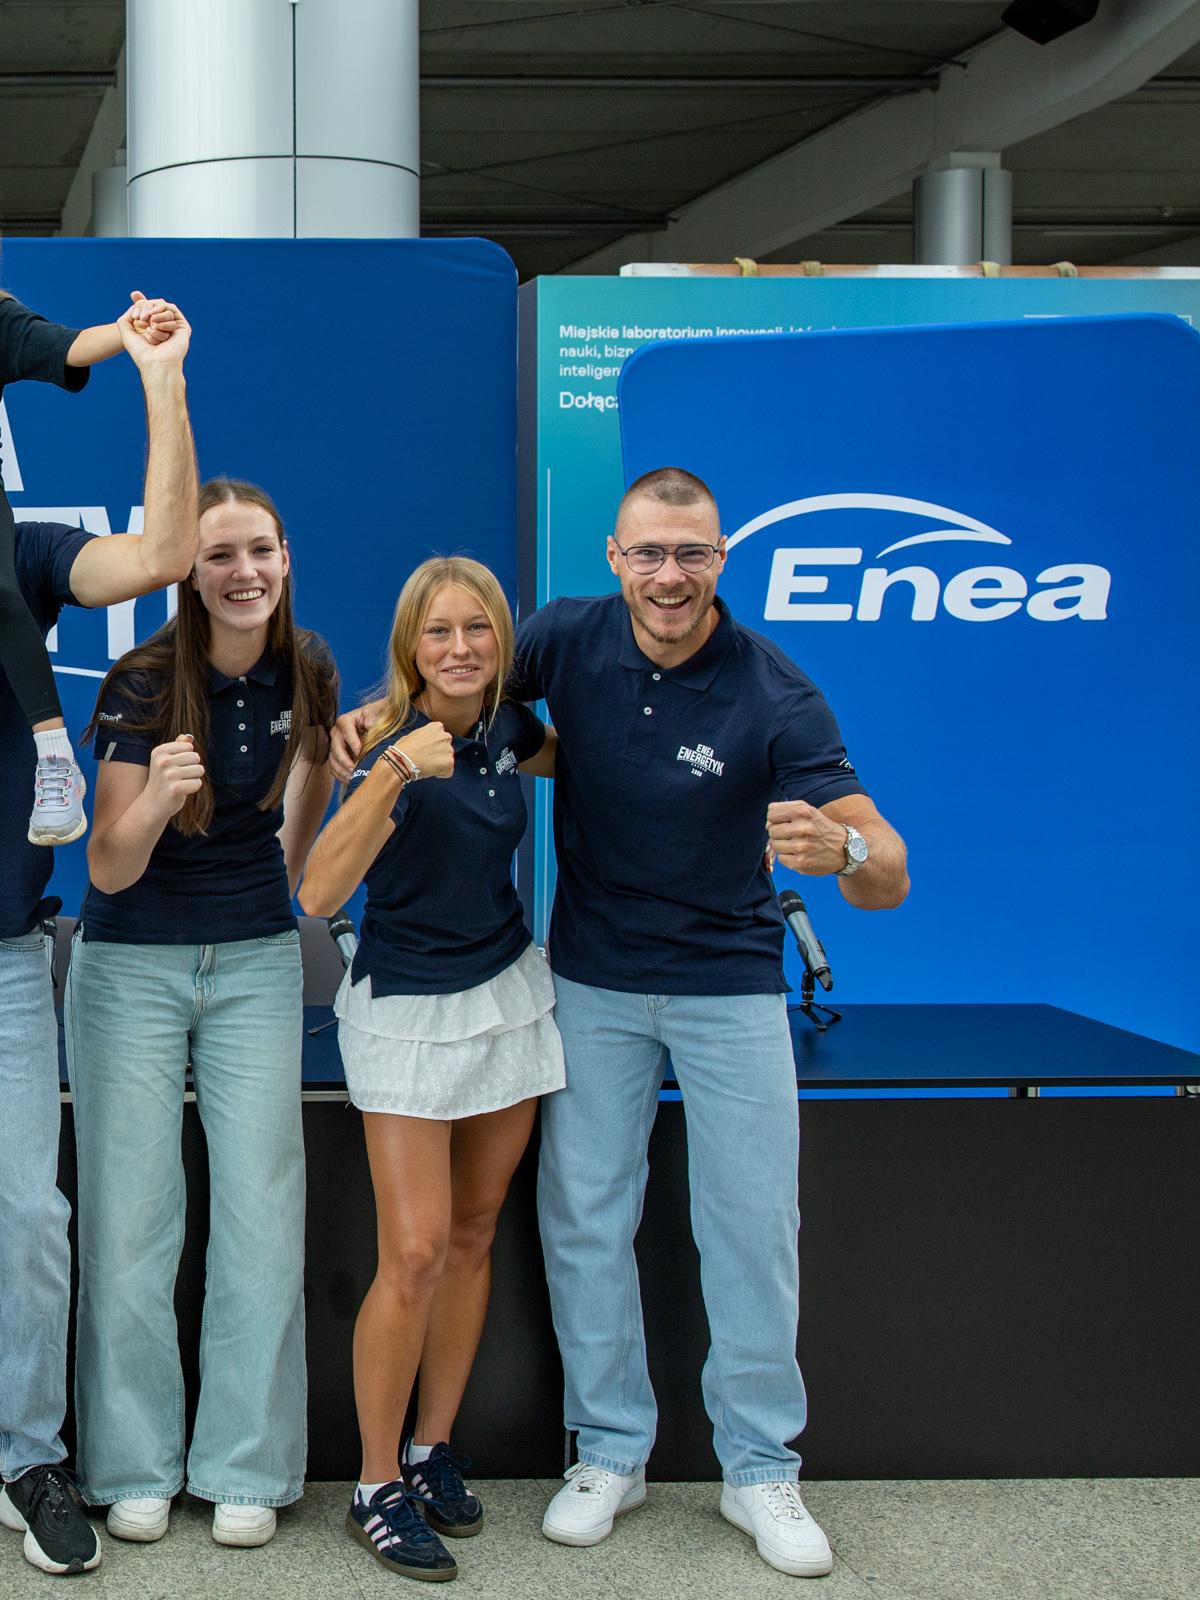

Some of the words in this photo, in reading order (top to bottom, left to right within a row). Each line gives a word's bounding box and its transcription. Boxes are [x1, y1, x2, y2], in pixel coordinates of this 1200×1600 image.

[560, 325, 620, 341] Miejskie
[622, 325, 713, 338] laboratorium
[560, 344, 602, 359] nauki,
[604, 345, 638, 358] bizn
[764, 547, 1111, 622] Enea
[696, 744, 714, 757] ENEA
[677, 746, 724, 775] ENERGETYK
